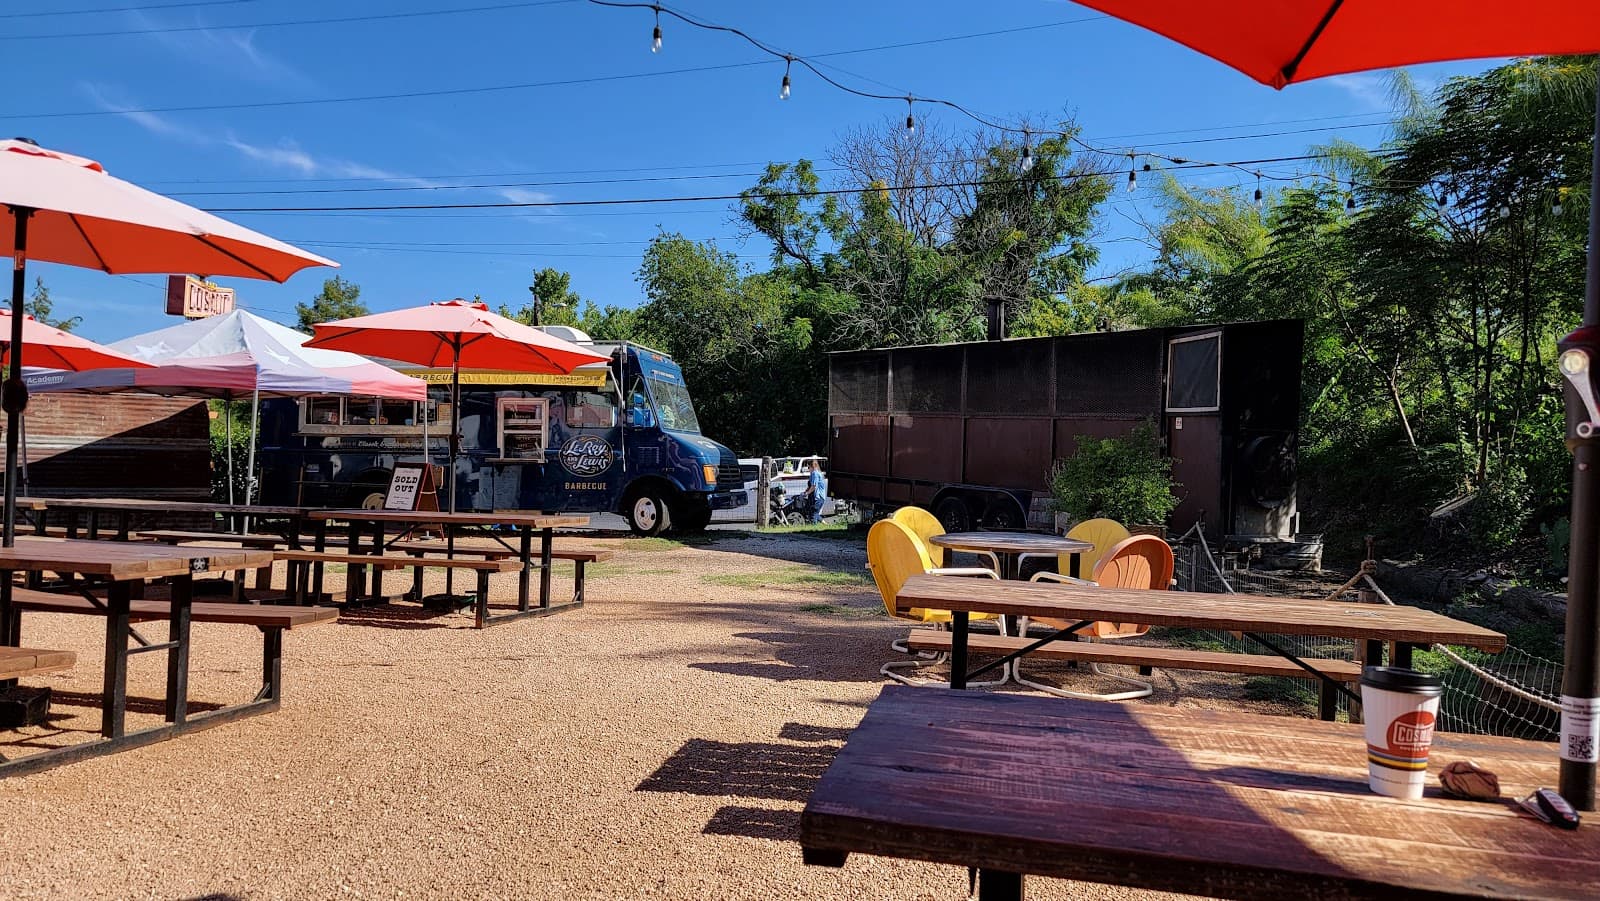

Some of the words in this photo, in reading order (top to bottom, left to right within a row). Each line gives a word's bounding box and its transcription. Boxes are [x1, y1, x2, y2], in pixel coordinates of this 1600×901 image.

[27, 376, 64, 384] Academy
[395, 475, 418, 483] SOLD
[564, 482, 607, 490] BARBECUE
